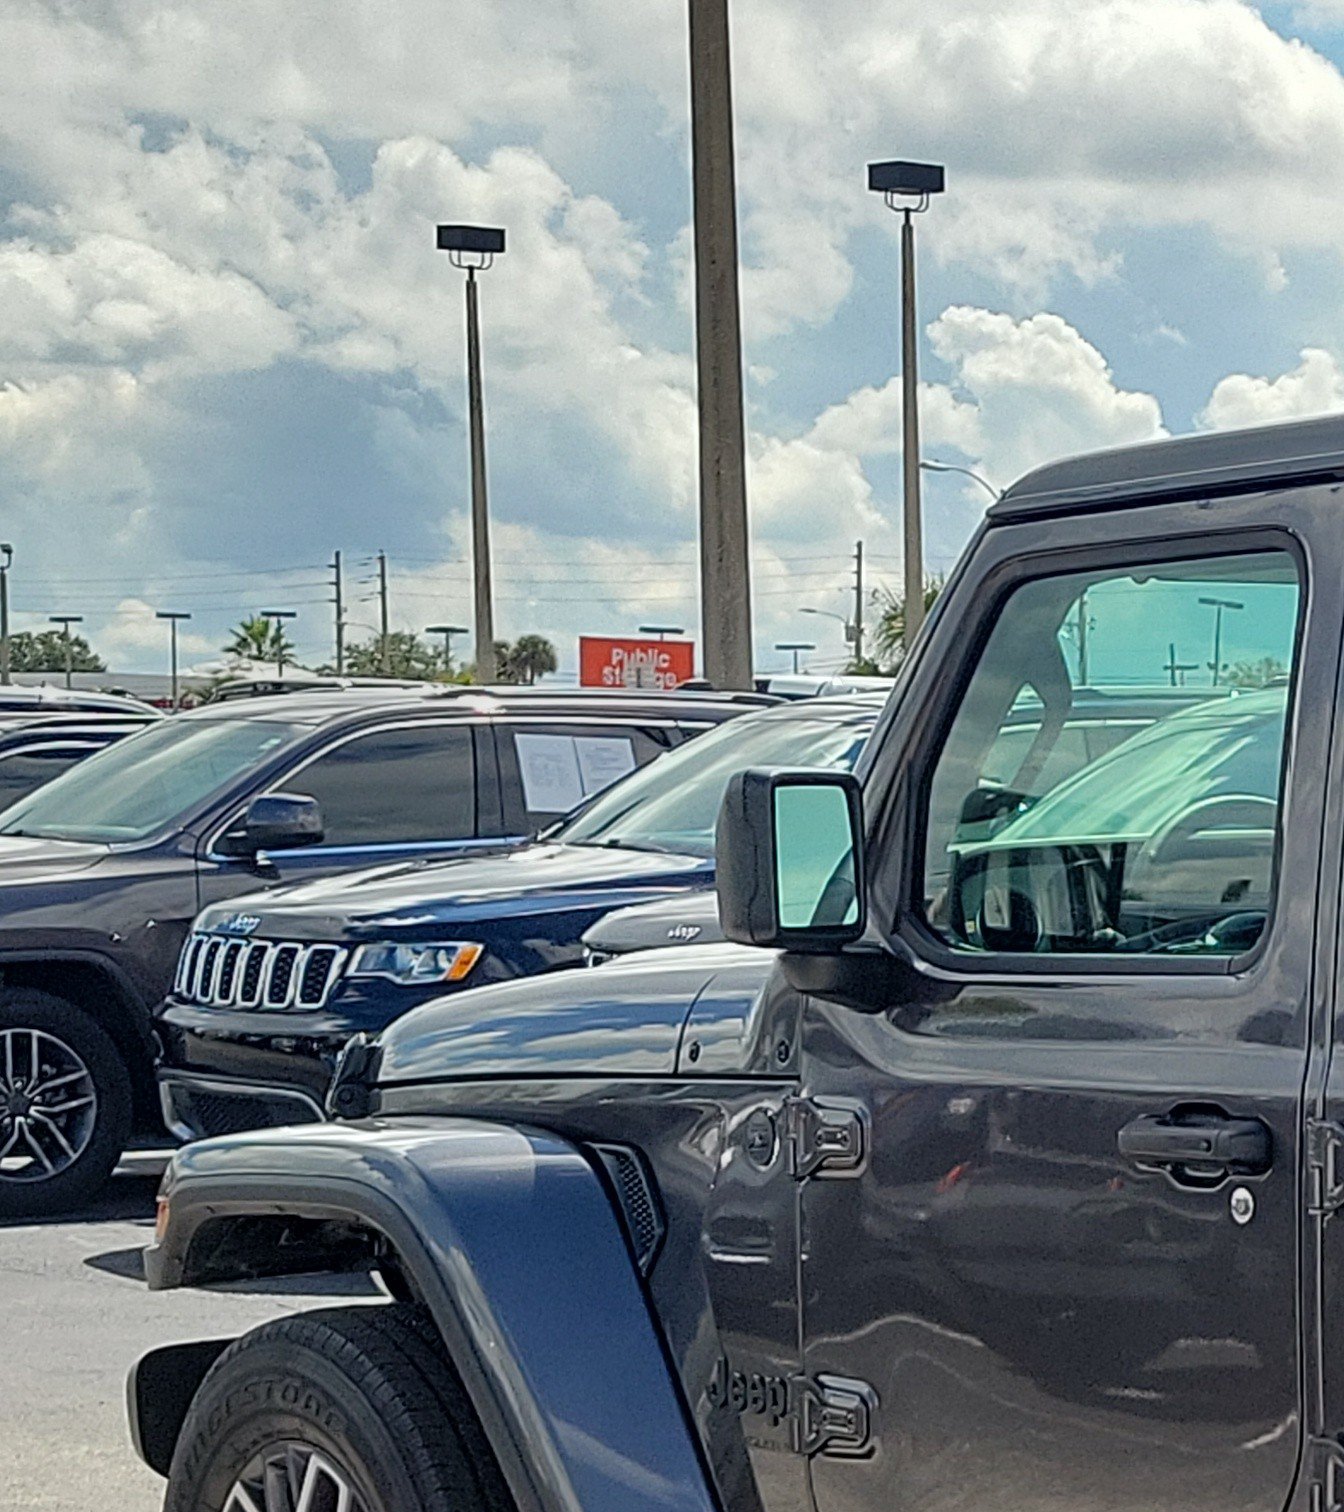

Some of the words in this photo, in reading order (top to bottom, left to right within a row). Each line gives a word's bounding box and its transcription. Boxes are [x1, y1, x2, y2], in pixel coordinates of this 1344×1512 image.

[611, 647, 671, 668] Public
[602, 665, 677, 688] Stge
[705, 1356, 788, 1427] Jeep
